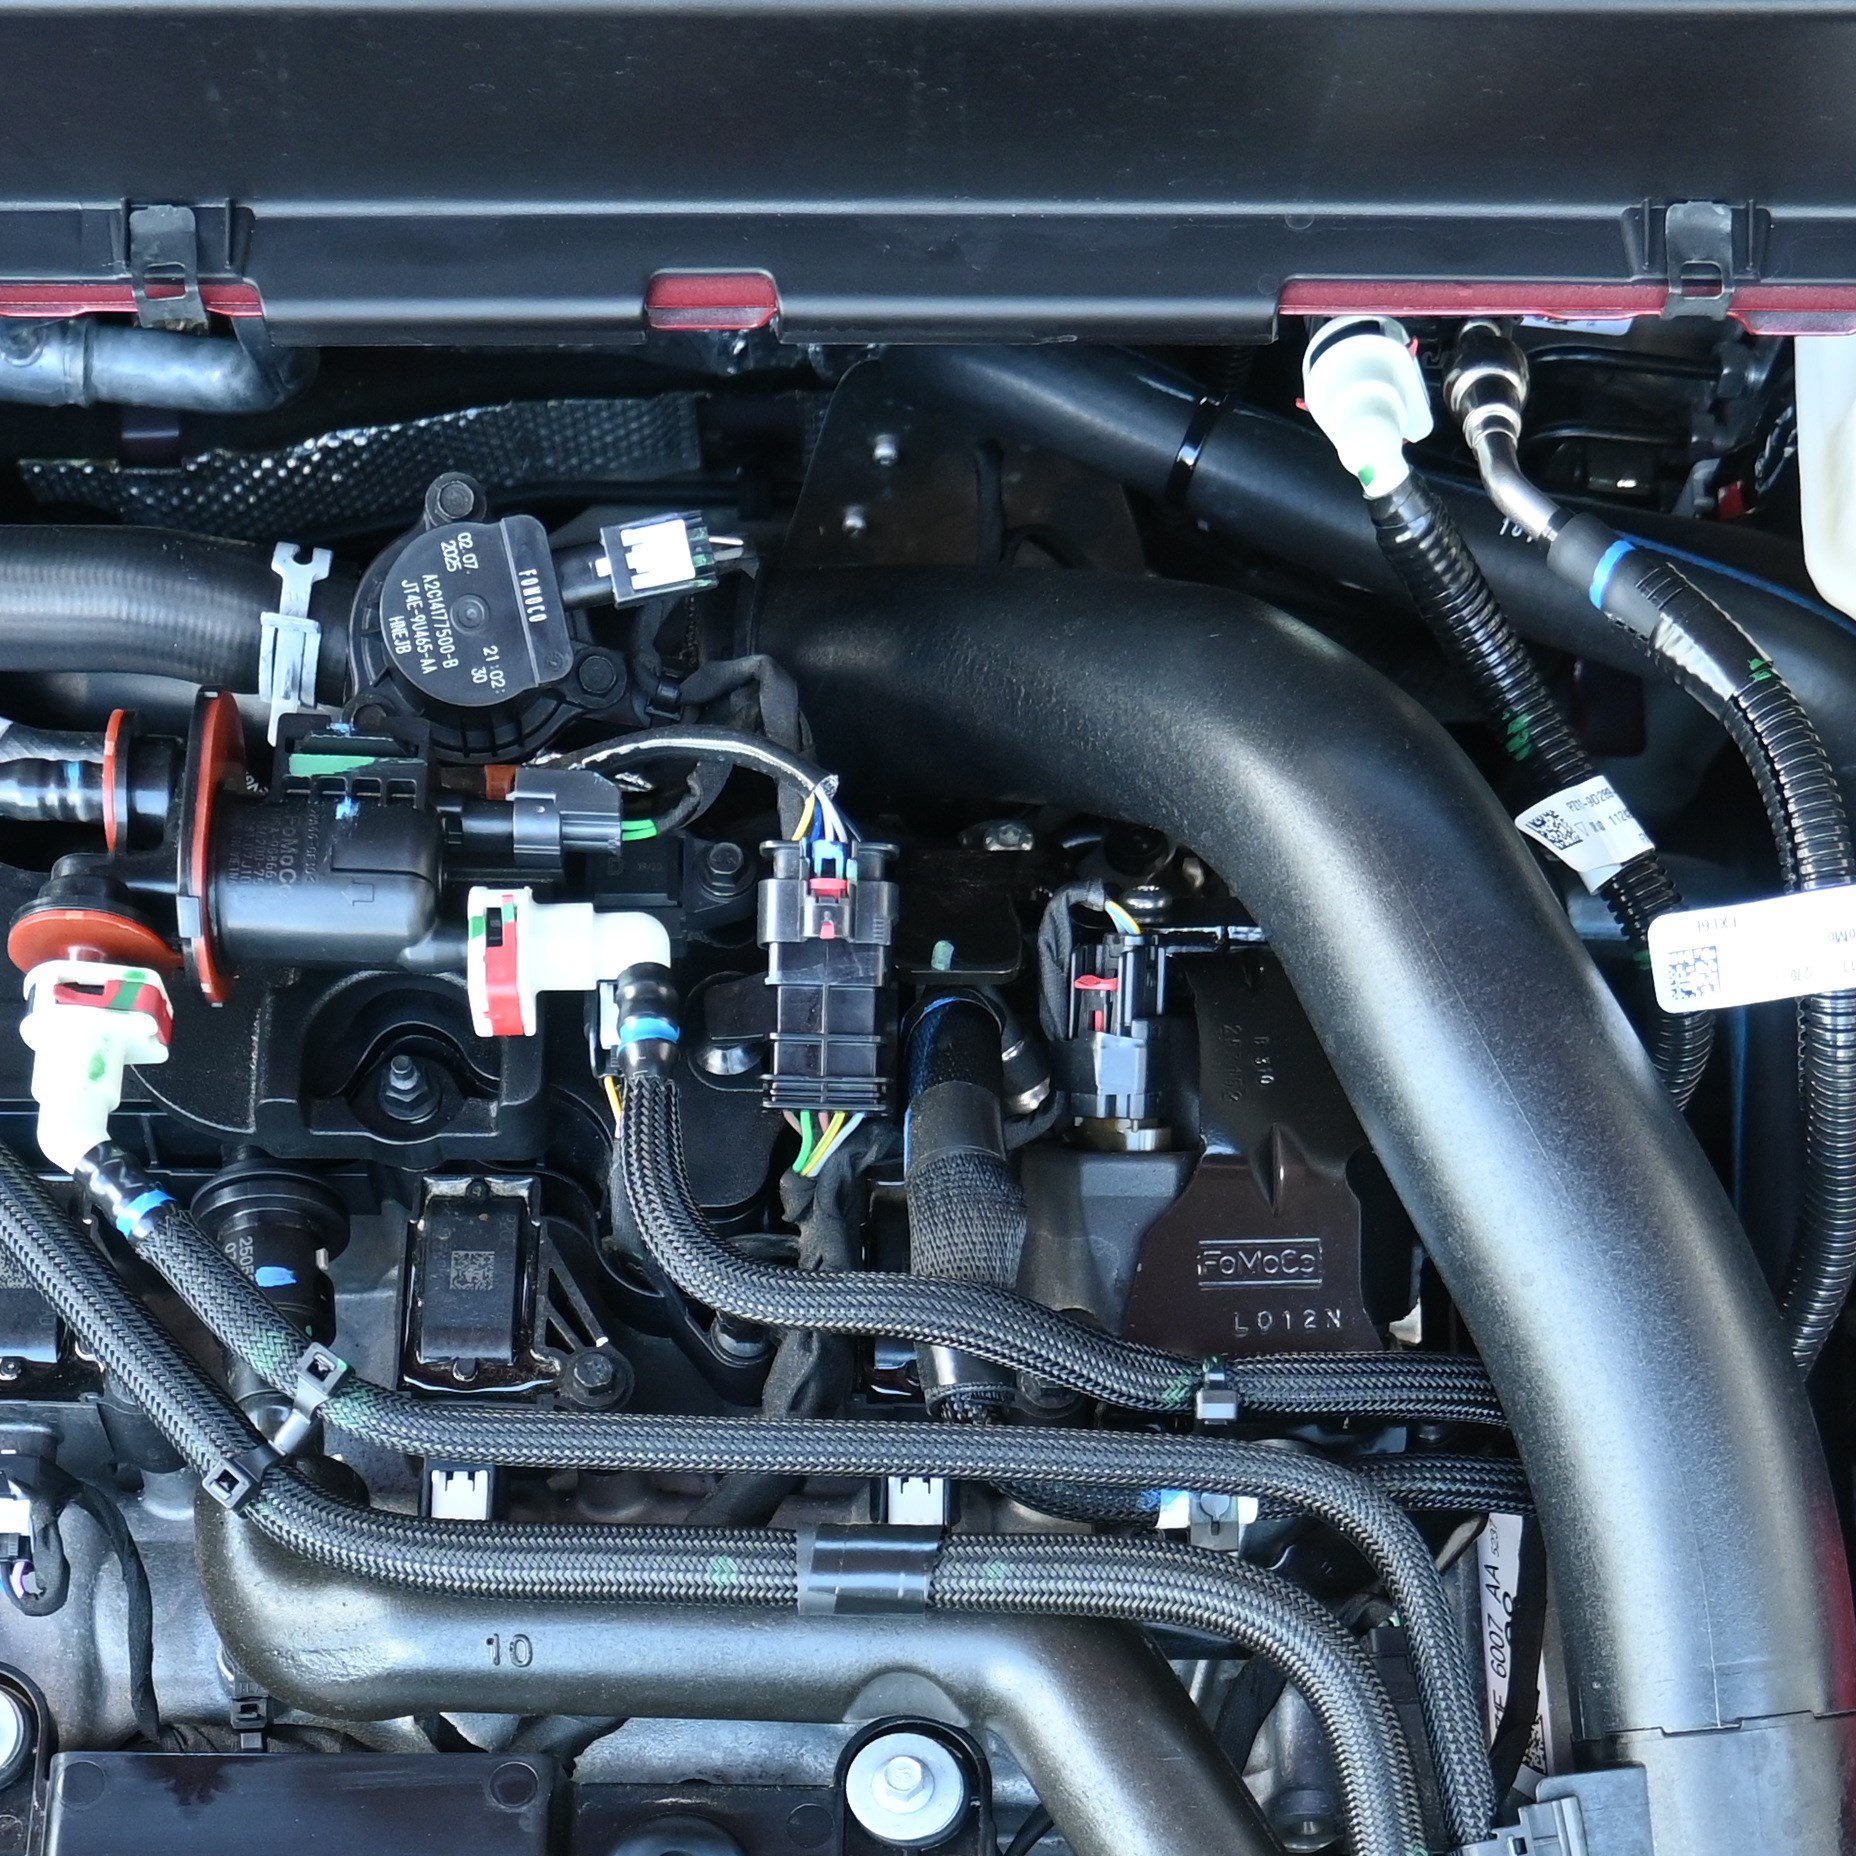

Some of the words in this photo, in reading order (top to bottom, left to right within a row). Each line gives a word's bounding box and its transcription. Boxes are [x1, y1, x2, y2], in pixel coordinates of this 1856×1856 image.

[440, 539, 461, 572] 2025
[470, 666, 487, 683] 30
[1203, 1248, 1314, 1274] FoMoCo
[1482, 1562, 1502, 1605] AA
[486, 1633, 533, 1667] 10
